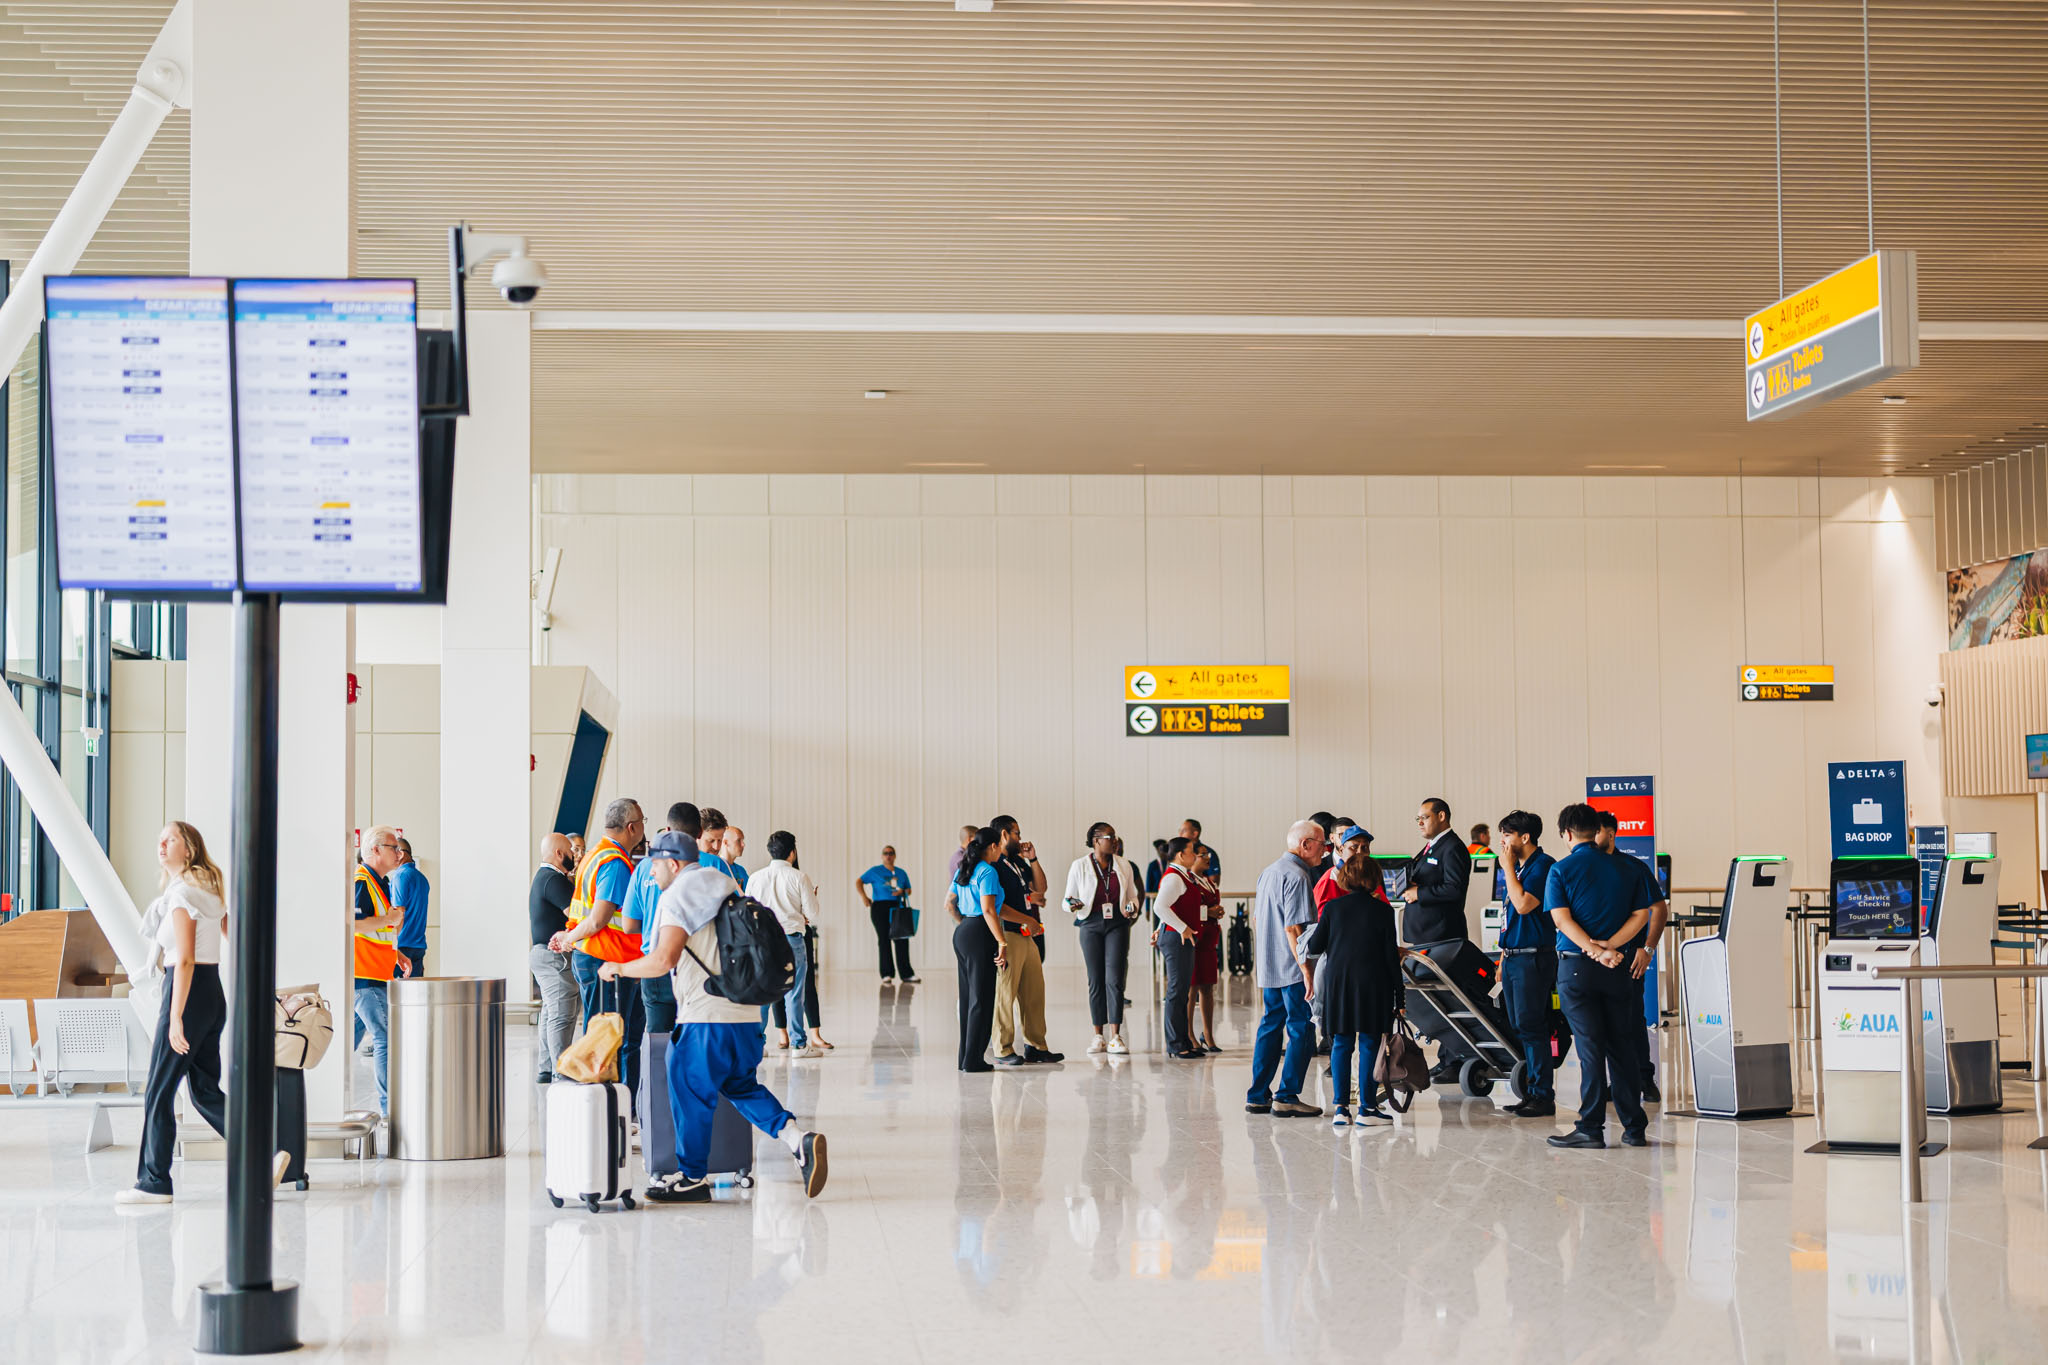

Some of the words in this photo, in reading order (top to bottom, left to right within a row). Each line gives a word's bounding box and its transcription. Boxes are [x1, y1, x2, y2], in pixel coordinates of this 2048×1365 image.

[1780, 303, 1792, 323] All
[1795, 296, 1819, 323] gates
[1792, 344, 1823, 373] Toilets
[1786, 668, 1807, 676] gates
[1190, 671, 1210, 682] All
[1216, 672, 1258, 686] gates
[1784, 684, 1810, 693] Toilets
[1209, 704, 1264, 720] Toilets
[1209, 720, 1242, 732] Baños
[1847, 769, 1885, 778] DELTA
[1603, 782, 1637, 790] DELTA
[1618, 820, 1645, 830] RITY
[1845, 833, 1864, 842] BAG
[1866, 833, 1892, 842] DROP
[1705, 1014, 1722, 1025] AUA
[1922, 1010, 1934, 1021] UA
[1859, 1013, 1899, 1032] AUA
